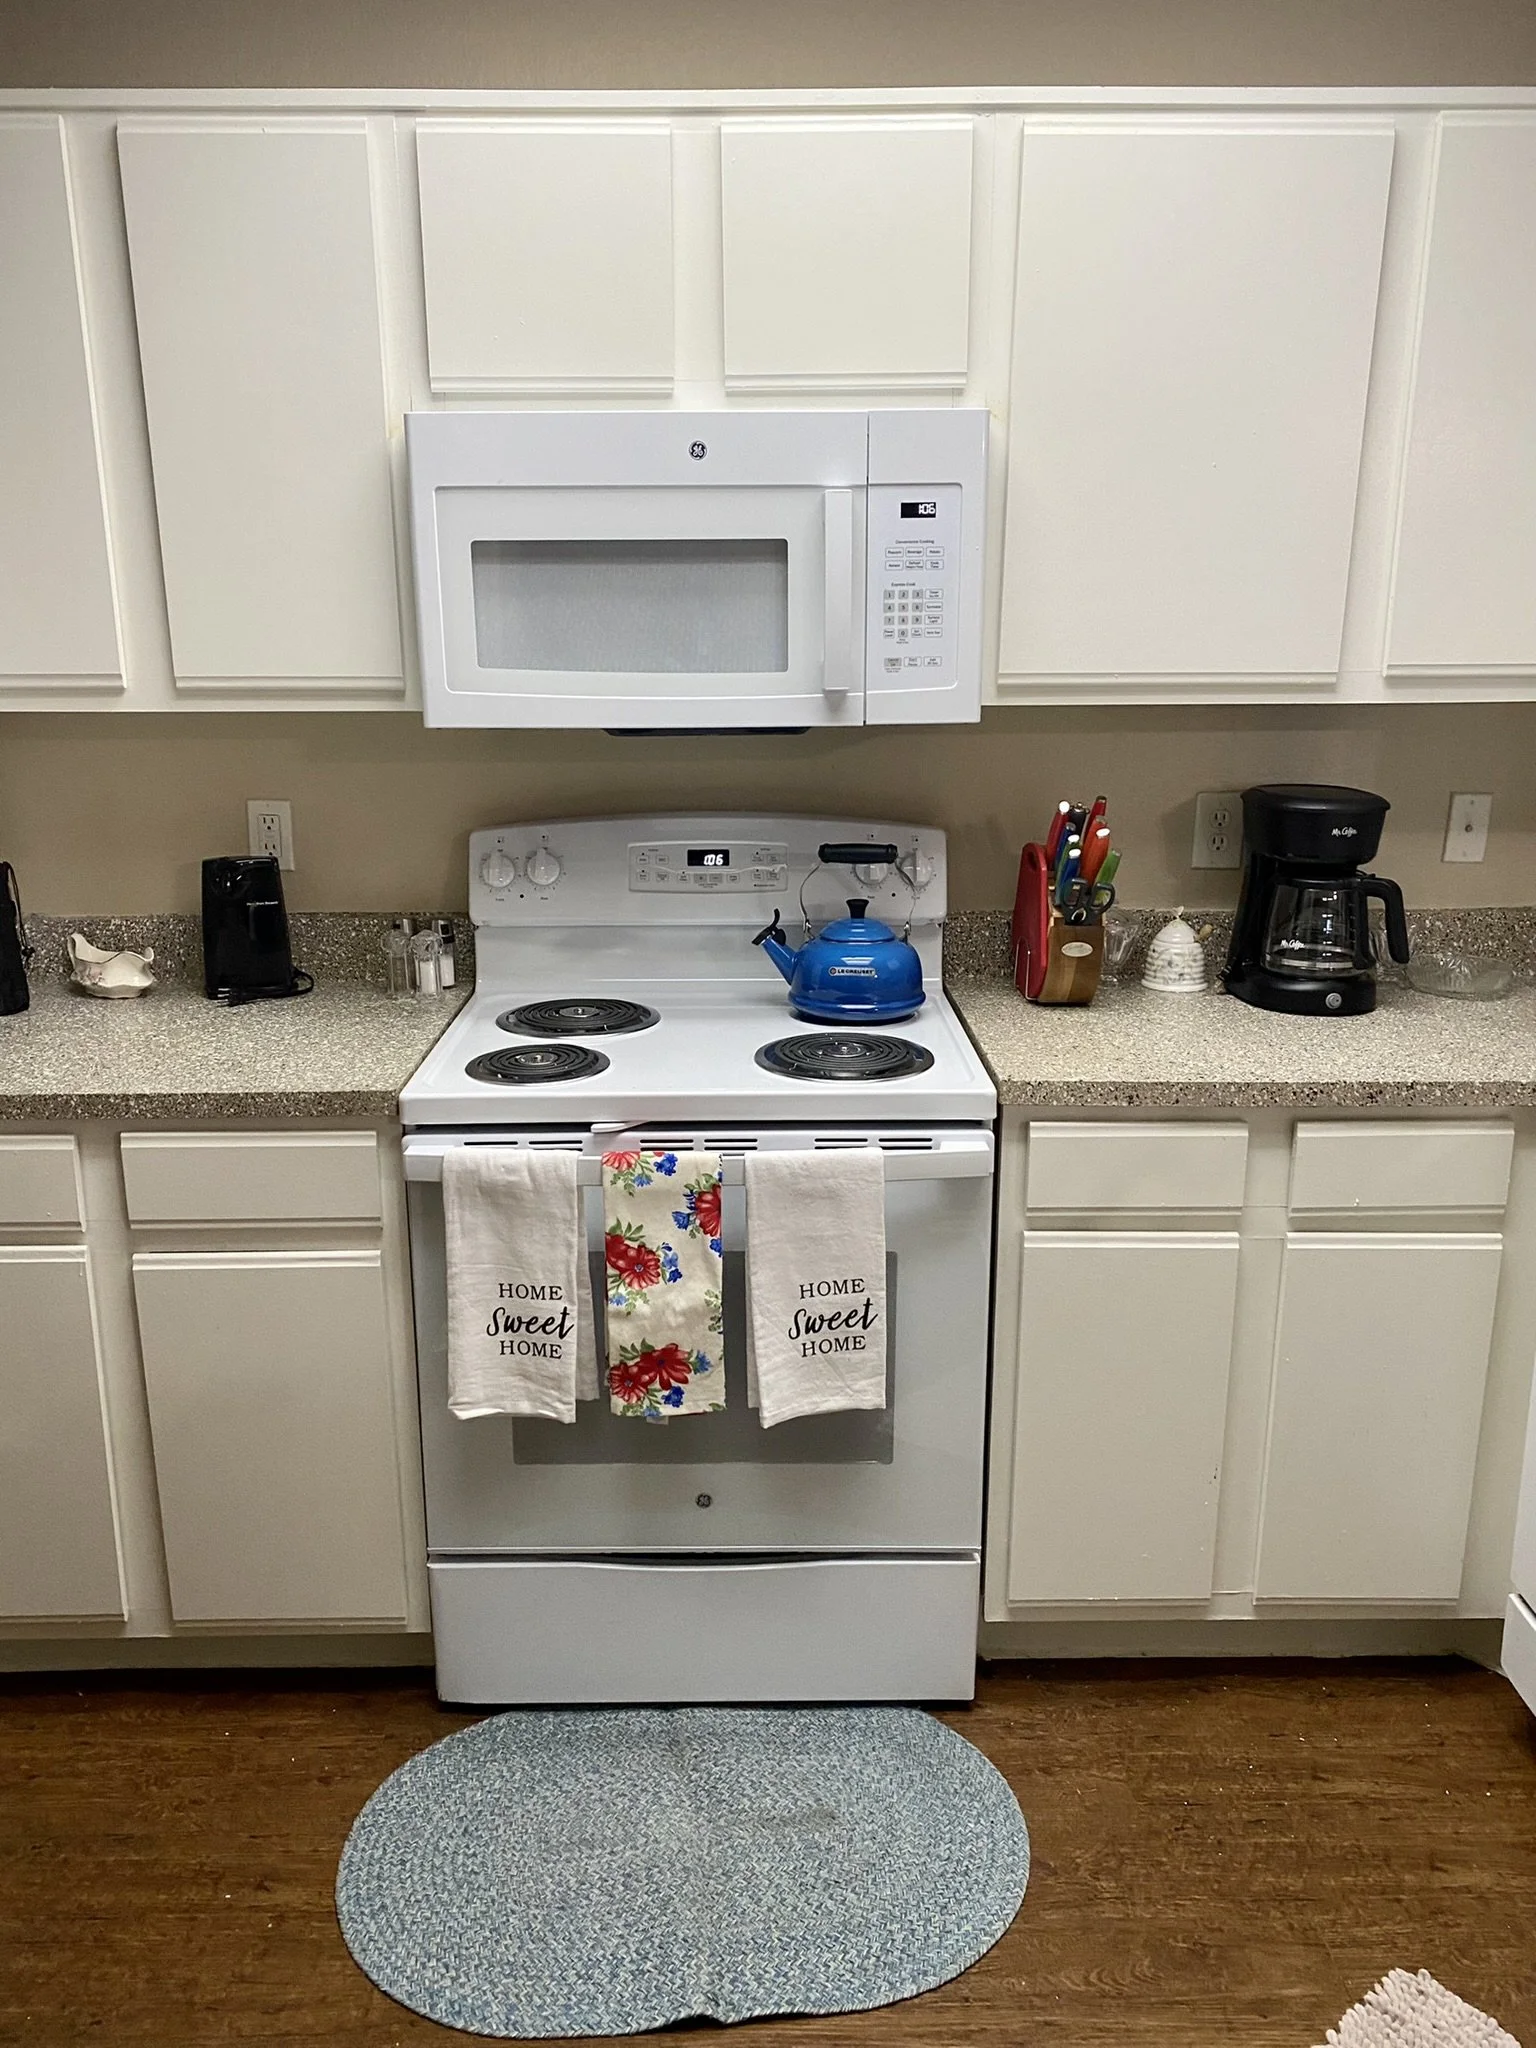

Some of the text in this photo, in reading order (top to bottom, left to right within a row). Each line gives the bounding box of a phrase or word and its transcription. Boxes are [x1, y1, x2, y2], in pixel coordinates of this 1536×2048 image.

[498, 1282, 563, 1301] HOME
[799, 1278, 866, 1299] HOME
[486, 1306, 575, 1340] Sweet
[788, 1297, 879, 1340] Sweet
[499, 1340, 563, 1359] HOME
[801, 1335, 867, 1358] HOME
